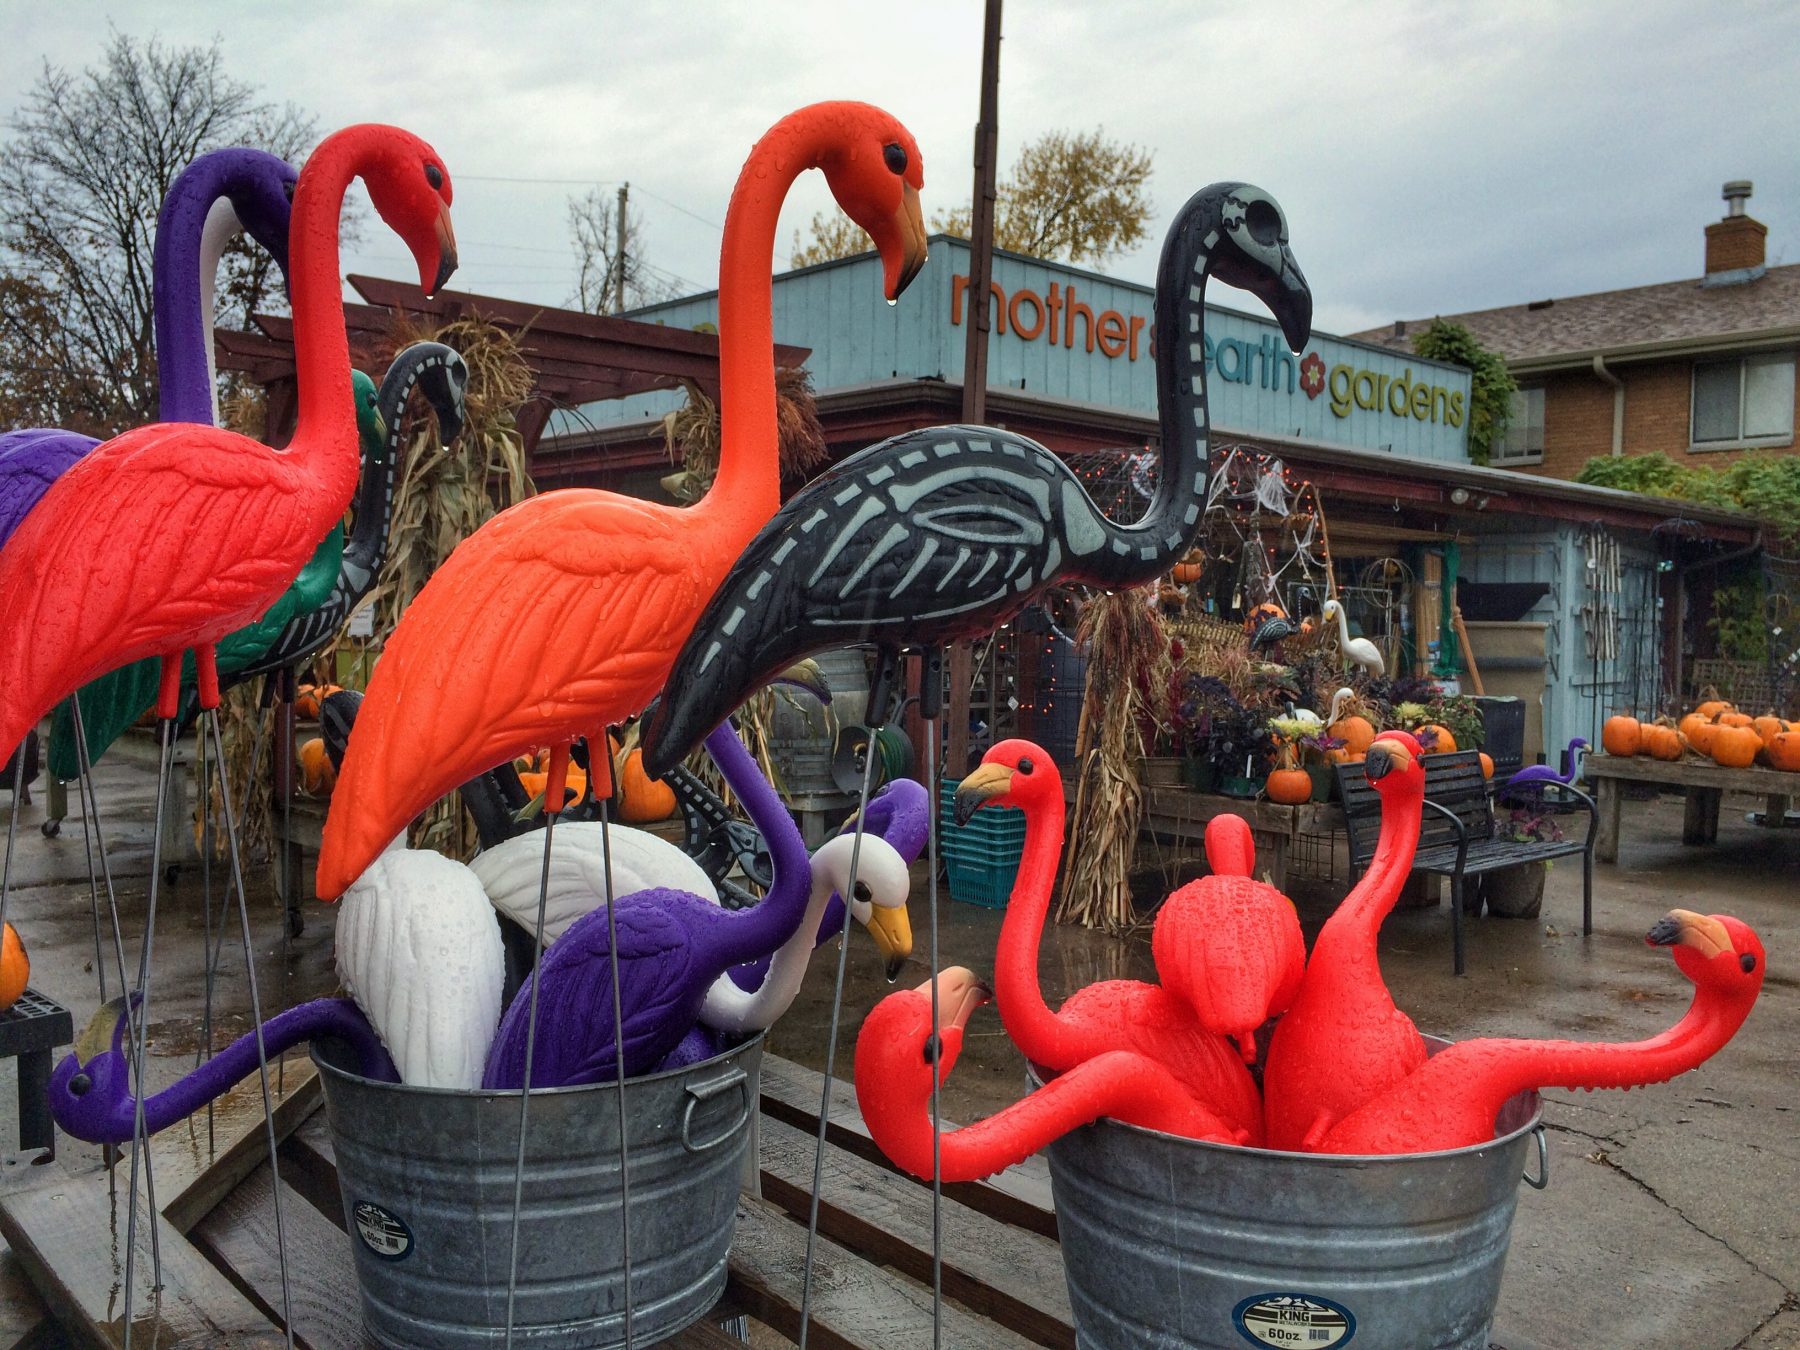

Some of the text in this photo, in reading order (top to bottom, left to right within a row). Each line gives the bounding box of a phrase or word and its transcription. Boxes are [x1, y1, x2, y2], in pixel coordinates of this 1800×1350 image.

[952, 273, 1145, 361] mother
[1329, 364, 1464, 428] gardens
[1279, 1310, 1310, 1322] KING
